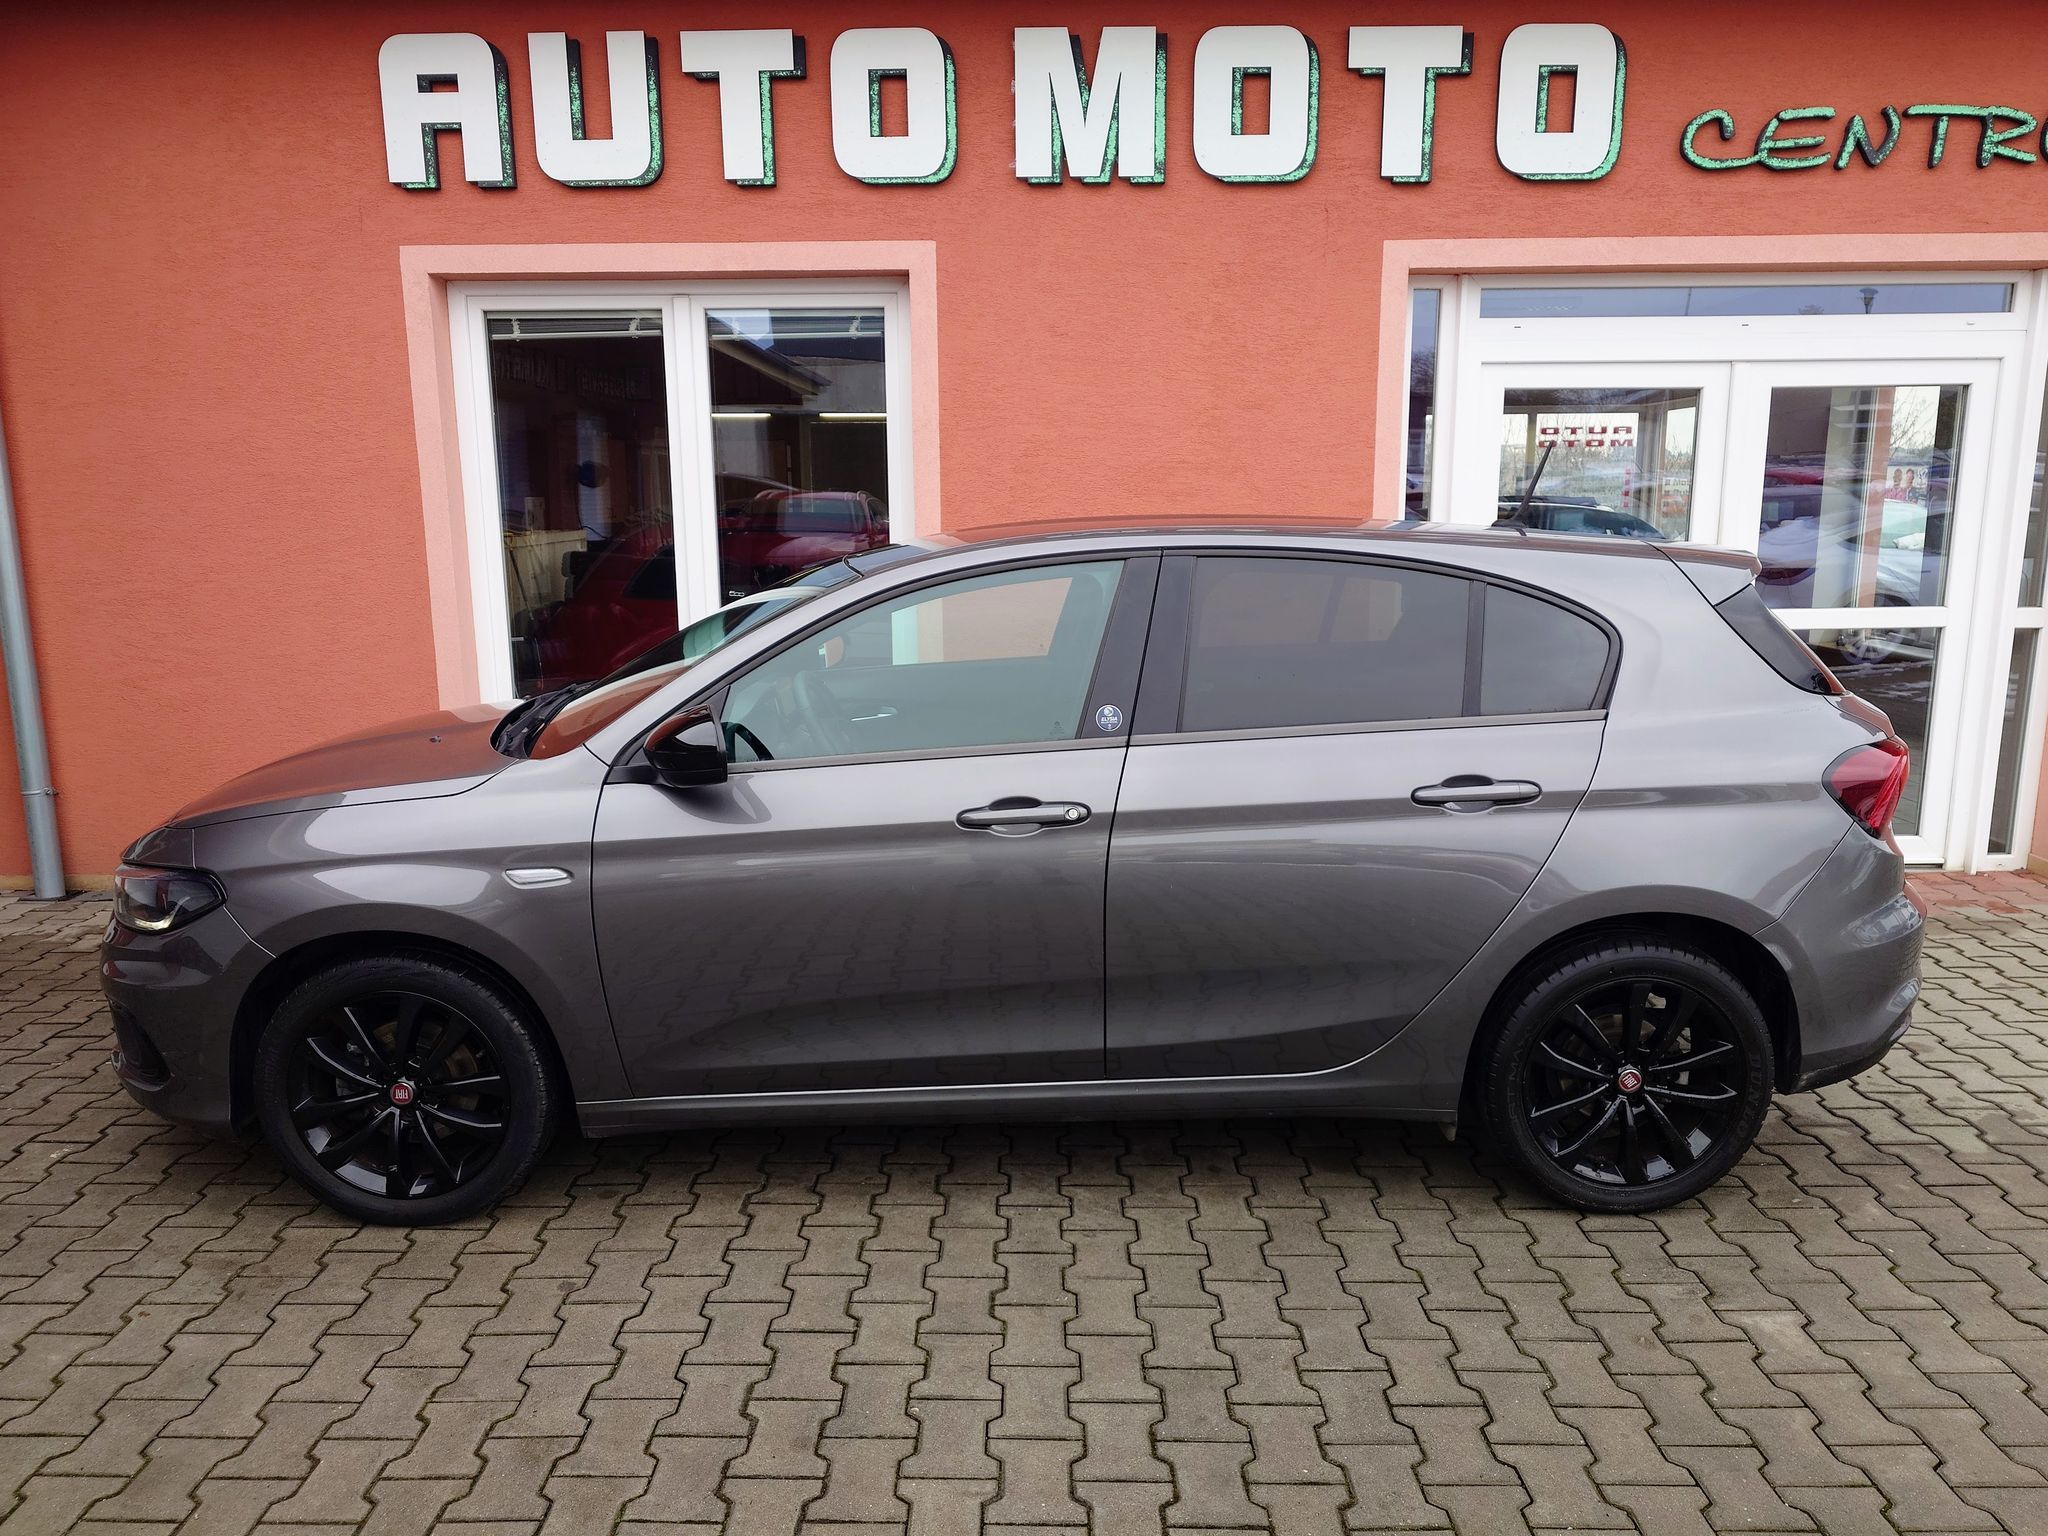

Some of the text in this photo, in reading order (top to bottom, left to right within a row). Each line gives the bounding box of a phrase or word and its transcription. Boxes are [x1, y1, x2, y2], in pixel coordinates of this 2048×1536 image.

[378, 23, 2048, 189] AUTO MOTO CENTR
[1622, 1073, 1637, 1088] FIAT
[395, 1089, 408, 1099] FIAT
